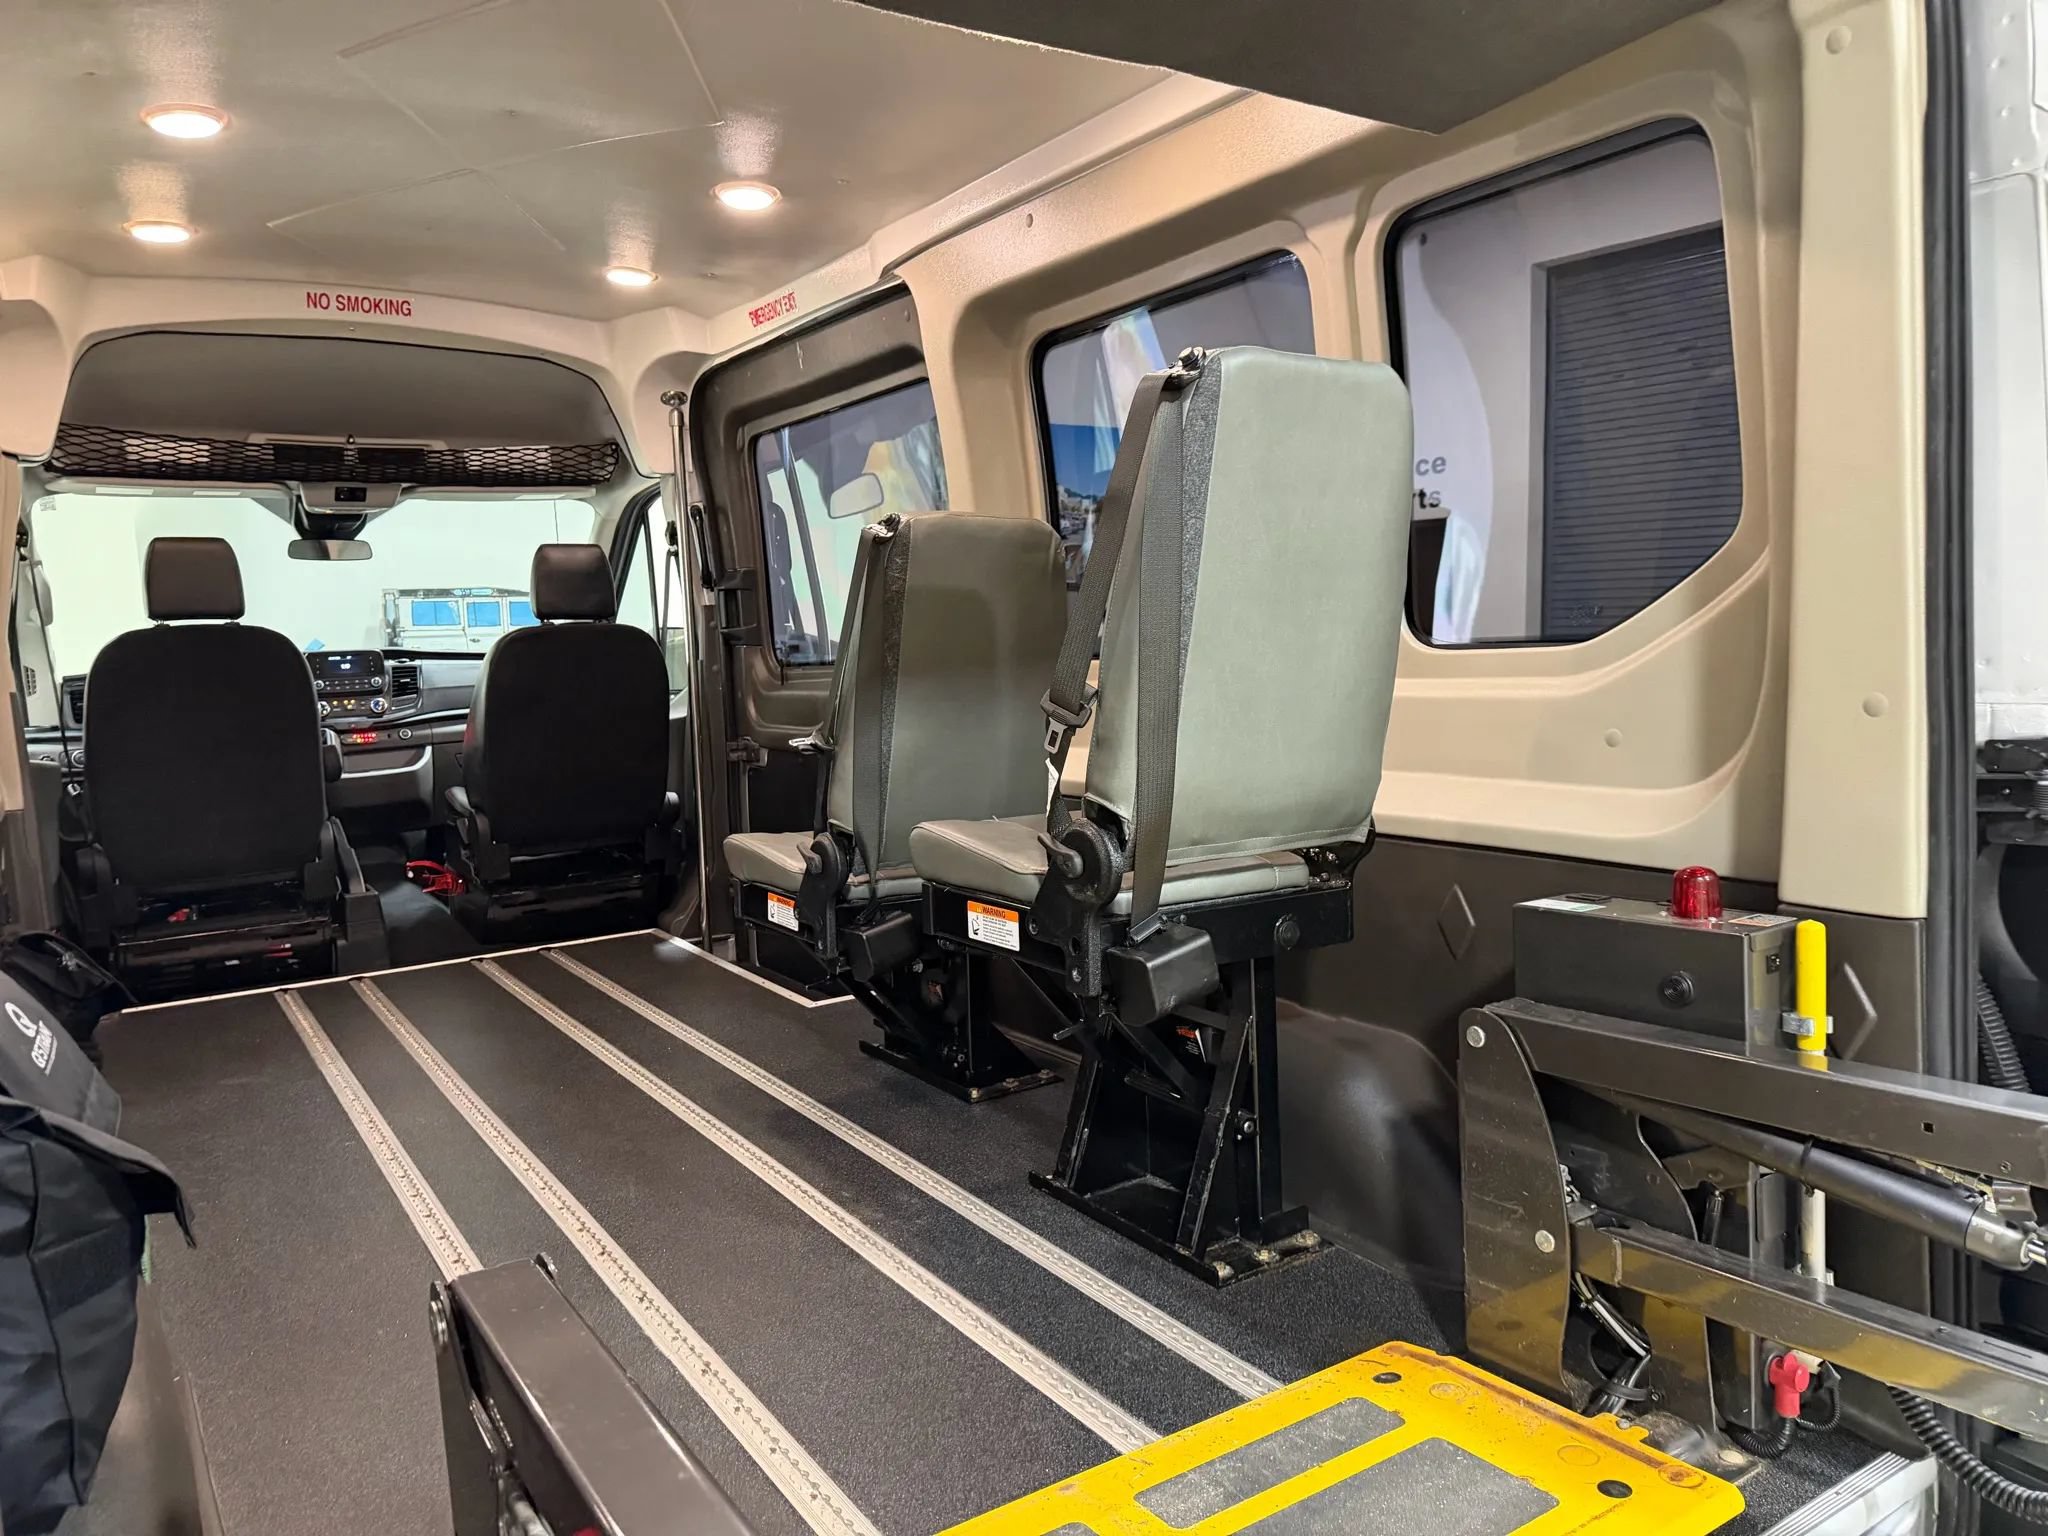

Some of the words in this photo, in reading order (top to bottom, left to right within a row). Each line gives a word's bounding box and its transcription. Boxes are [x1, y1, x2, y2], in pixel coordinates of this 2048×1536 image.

[306, 291, 330, 310] NO
[335, 294, 412, 317] SMOKING
[748, 296, 784, 328] EMERGENCY
[782, 291, 798, 312] EXIT
[982, 905, 1006, 919] WARNING
